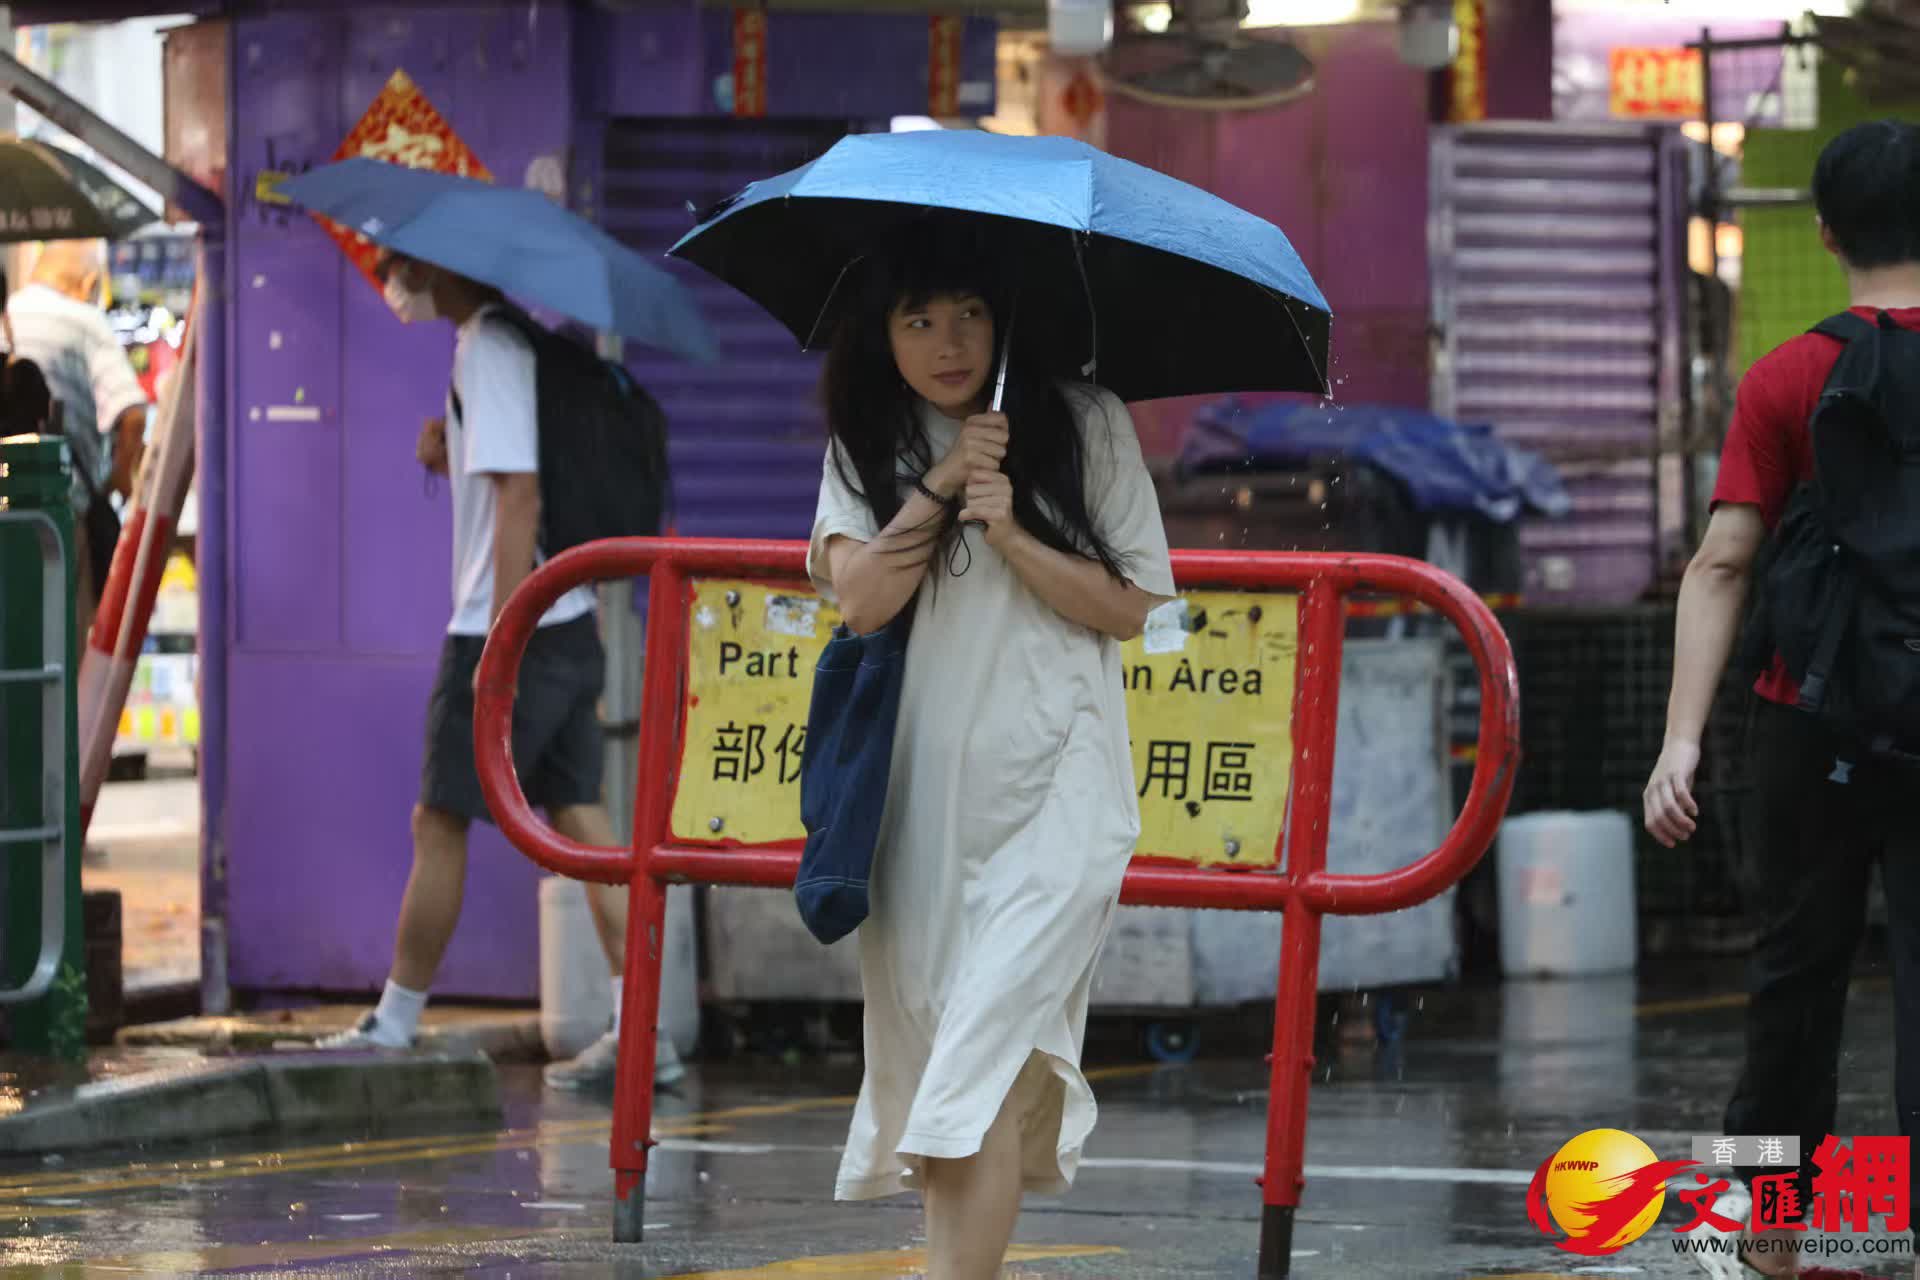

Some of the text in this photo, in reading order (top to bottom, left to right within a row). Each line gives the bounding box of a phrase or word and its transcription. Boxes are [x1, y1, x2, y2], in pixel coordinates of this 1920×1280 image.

[719, 641, 1262, 695] Part n Area
[1131, 739, 1256, 802] 用區
